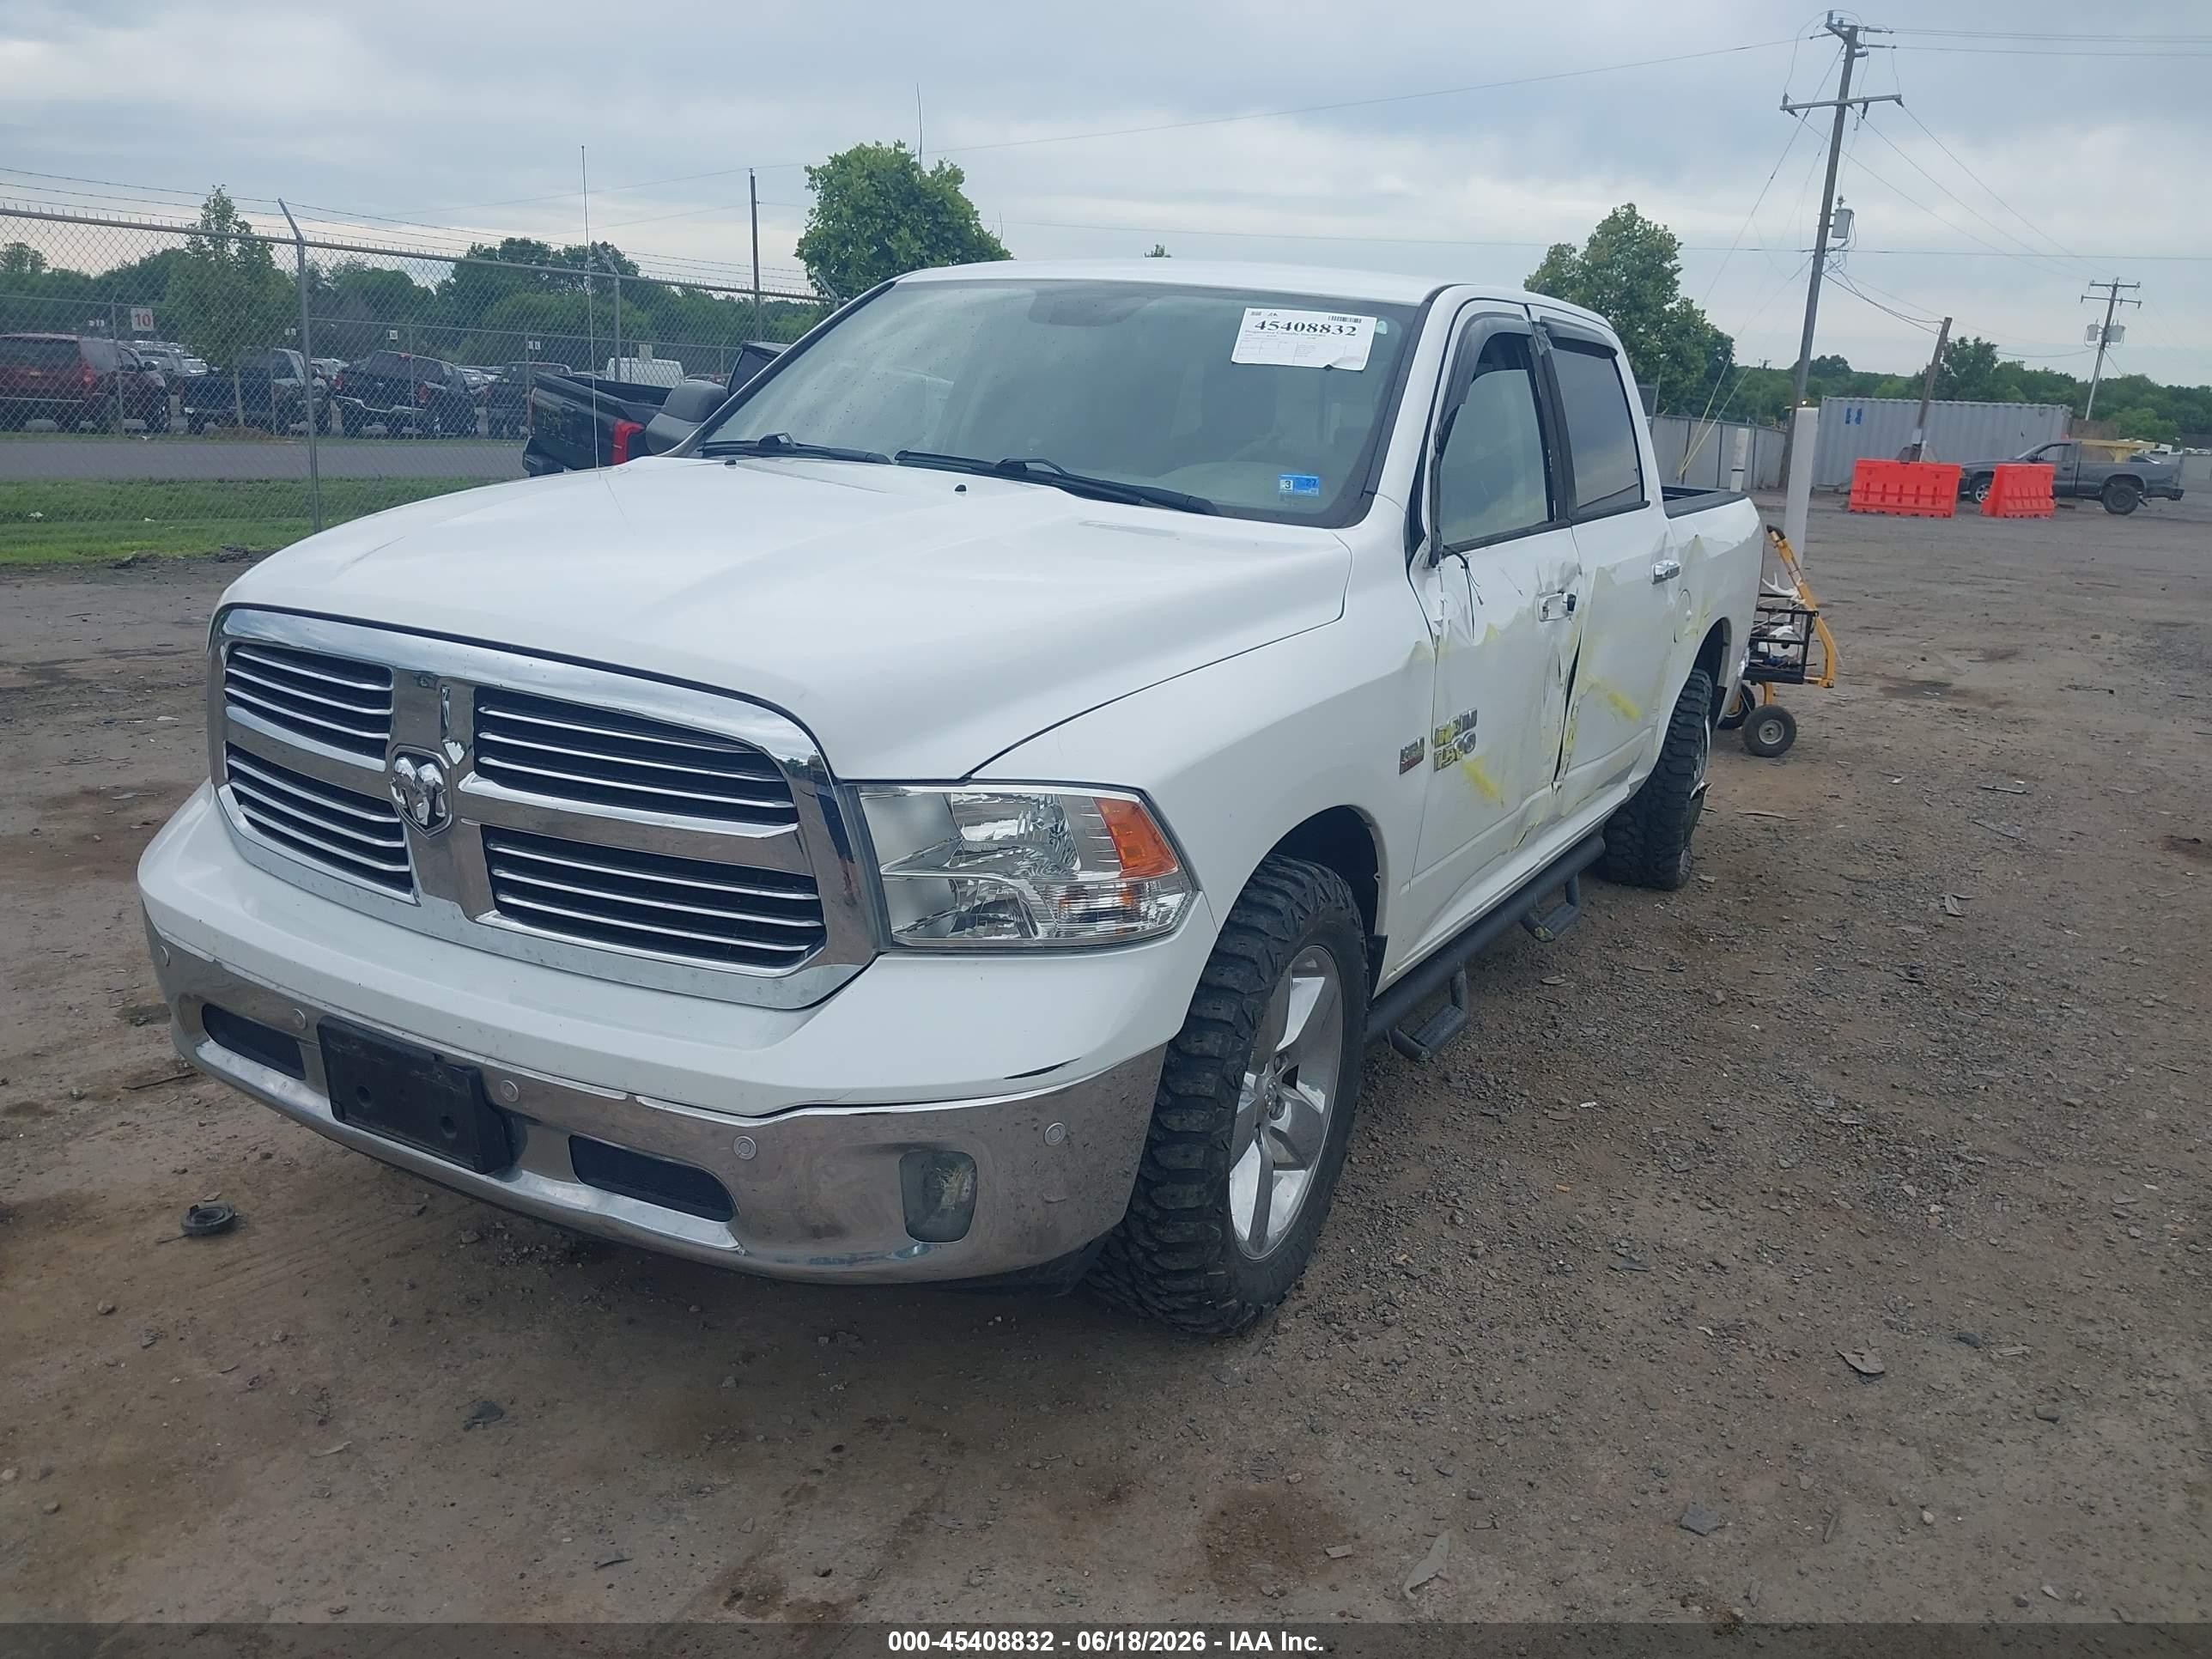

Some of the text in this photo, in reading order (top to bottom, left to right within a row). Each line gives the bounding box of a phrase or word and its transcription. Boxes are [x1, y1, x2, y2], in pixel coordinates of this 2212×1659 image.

[135, 313, 151, 326] 10
[1255, 319, 1357, 337] 45408832
[1285, 480, 1291, 489] 3
